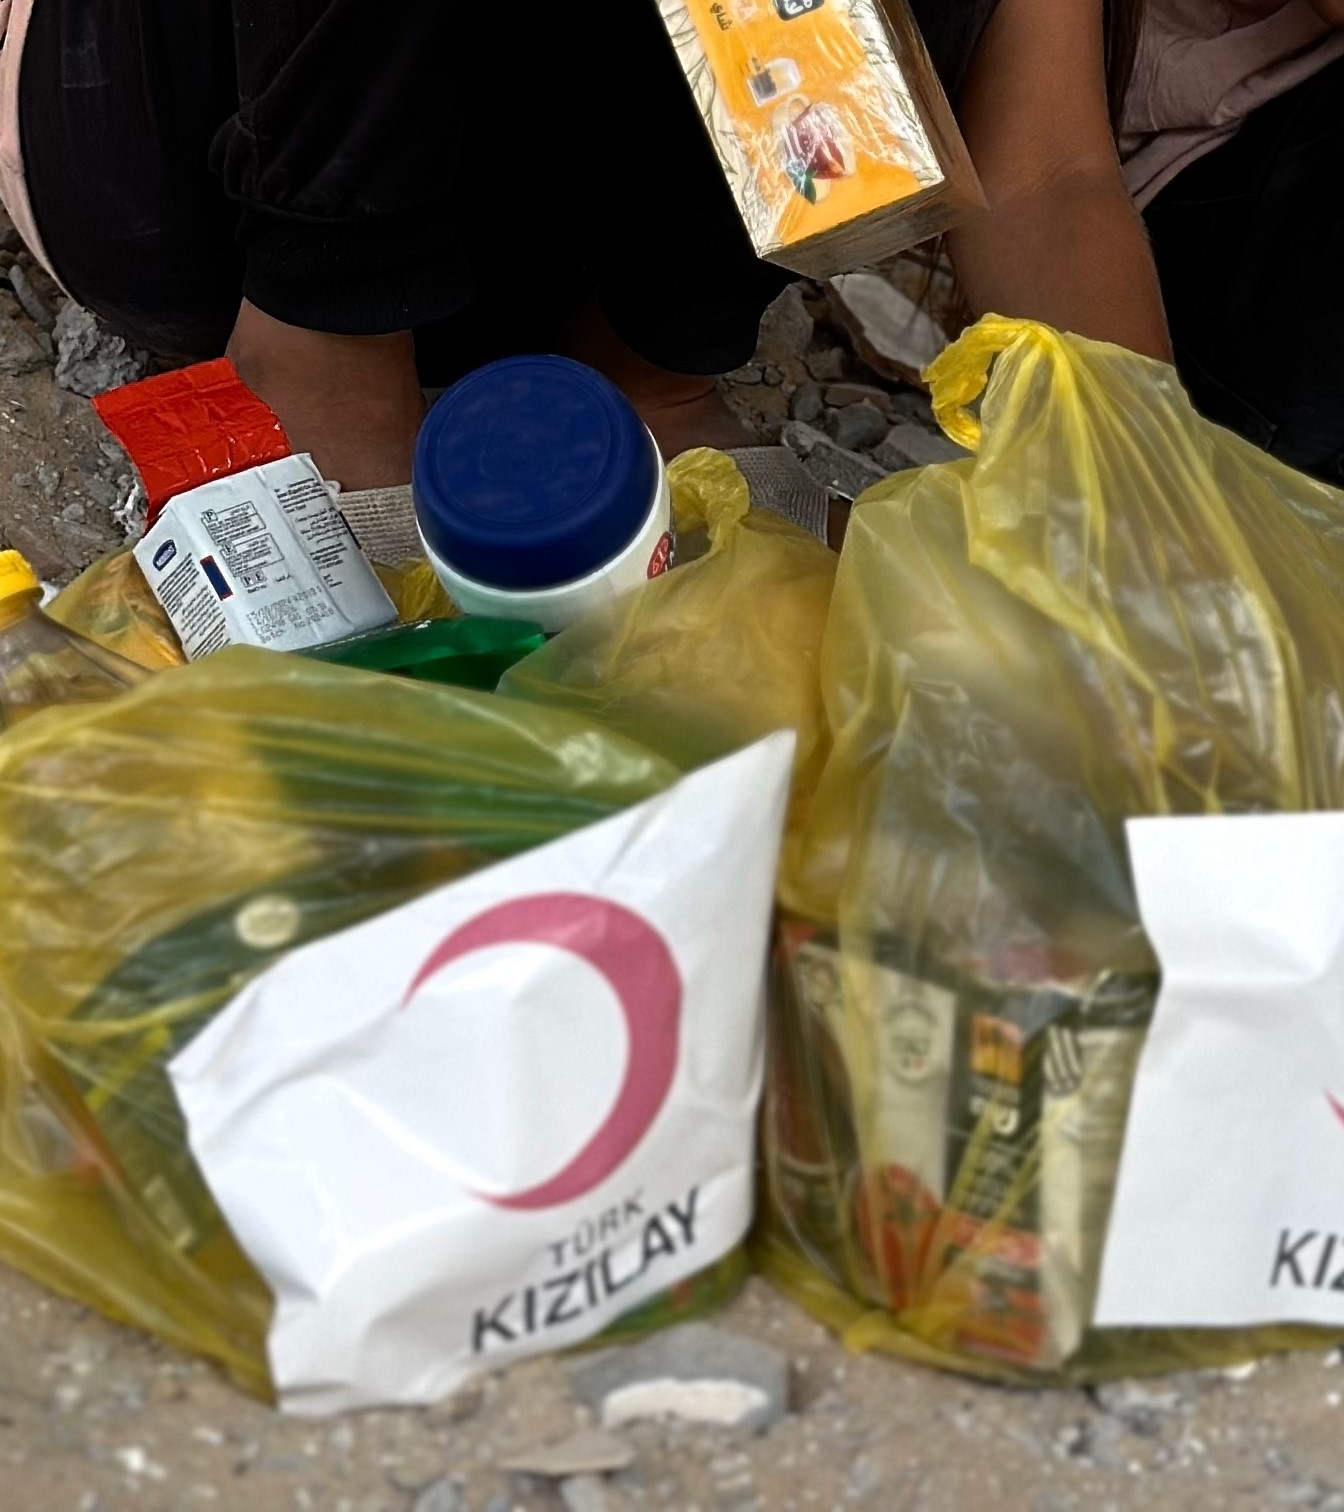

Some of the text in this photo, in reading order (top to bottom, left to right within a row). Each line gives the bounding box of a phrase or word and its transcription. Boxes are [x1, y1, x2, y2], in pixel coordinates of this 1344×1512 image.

[710, 2, 733, 31] شاي
[550, 1187, 644, 1266] TÜRK
[473, 1187, 698, 1352] KIZILAY
